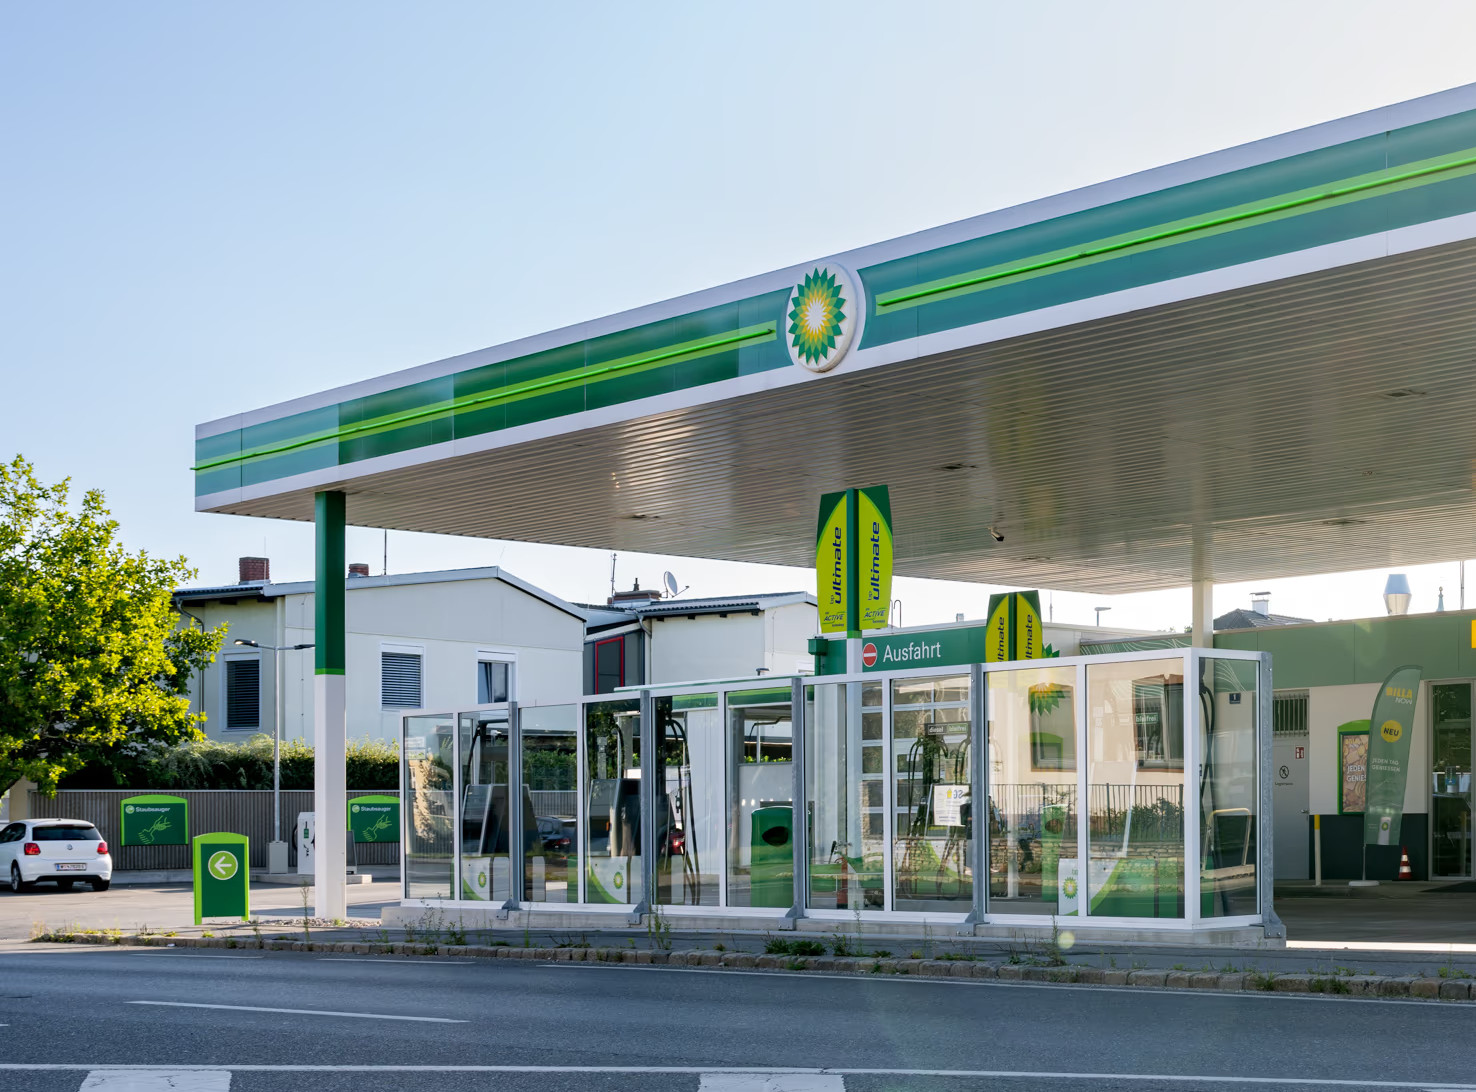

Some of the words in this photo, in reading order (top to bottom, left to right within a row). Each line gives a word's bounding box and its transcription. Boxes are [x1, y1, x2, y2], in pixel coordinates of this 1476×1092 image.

[832, 527, 841, 604] ultimate
[871, 522, 880, 600] ultimate
[864, 610, 885, 618] ACTIVE
[883, 641, 941, 662] Ausfahrt
[1386, 687, 1412, 699] BILLA
[1384, 728, 1399, 736] NEU
[1347, 765, 1364, 773] JEDEN
